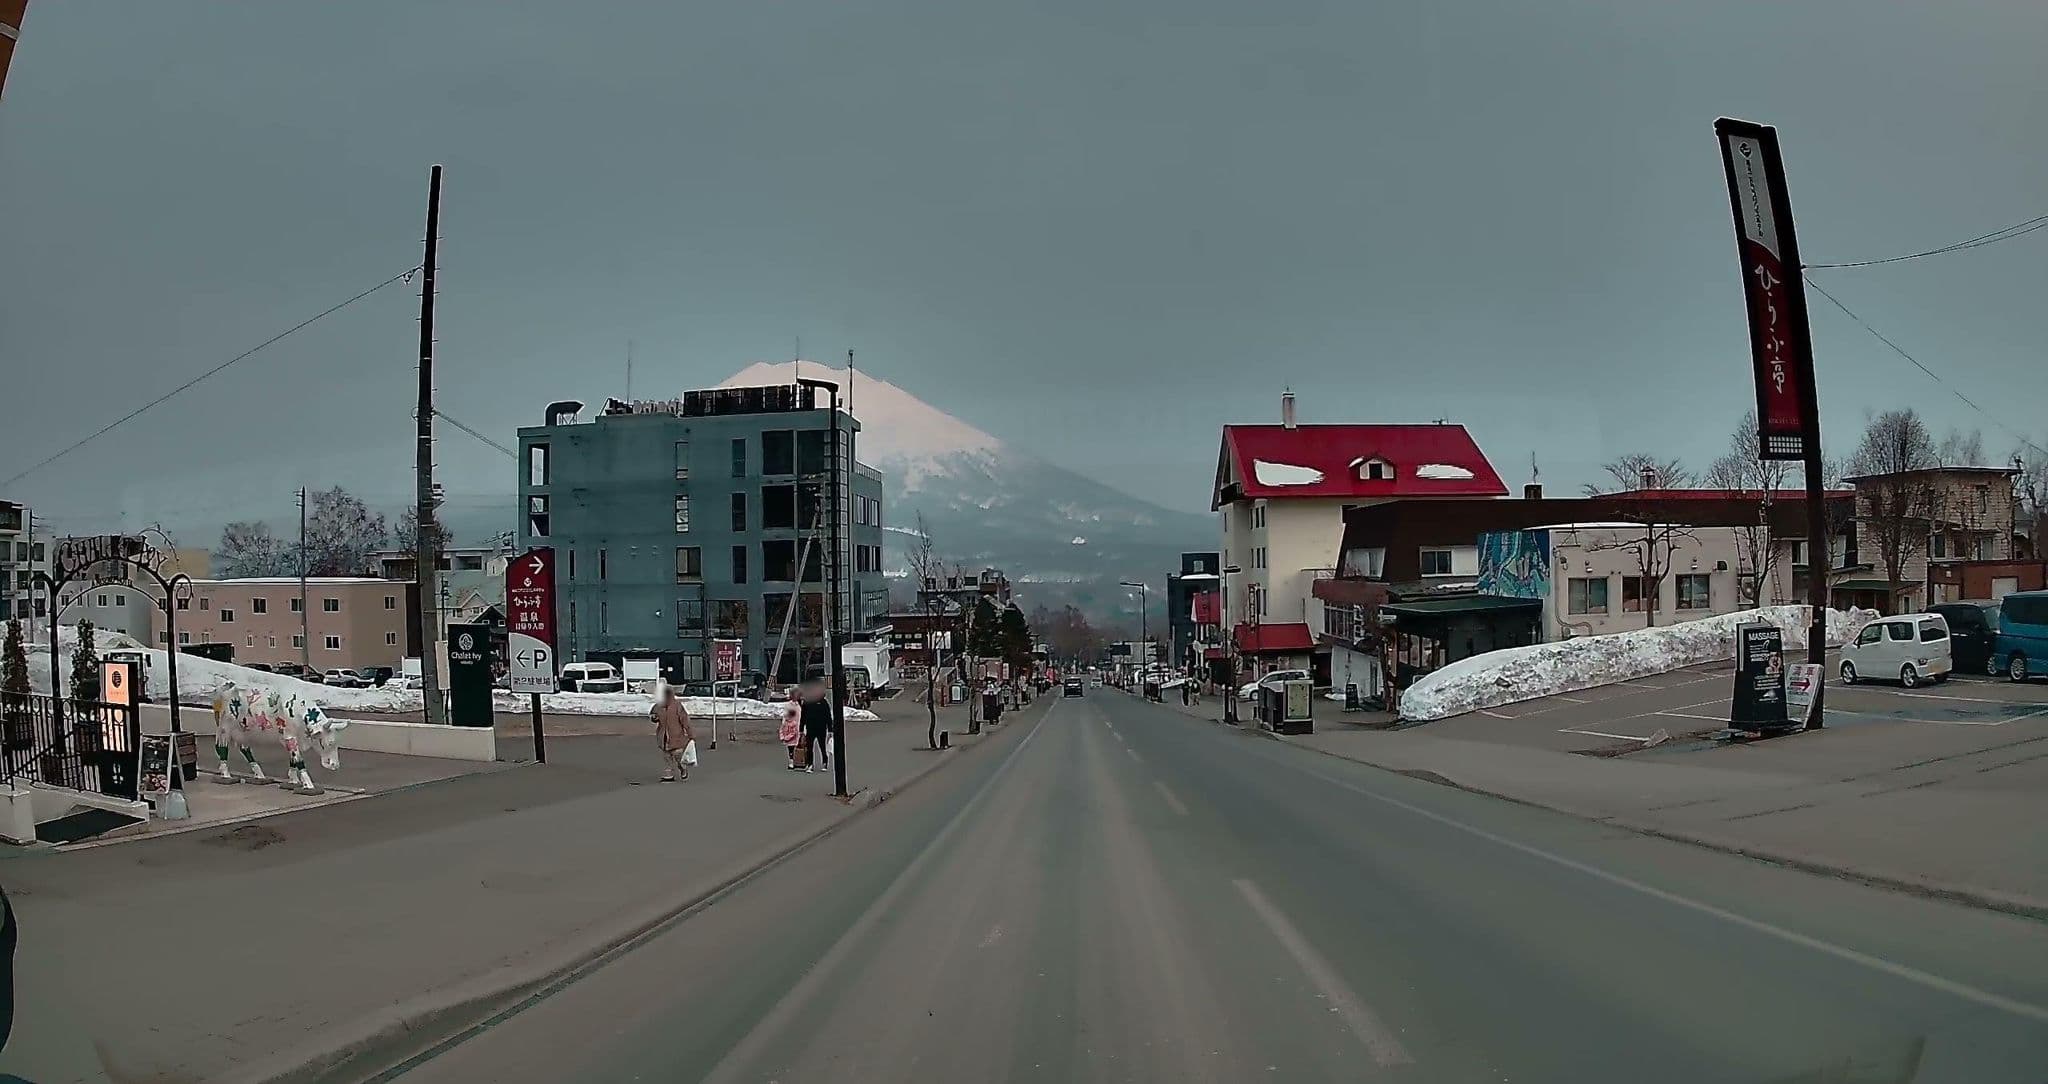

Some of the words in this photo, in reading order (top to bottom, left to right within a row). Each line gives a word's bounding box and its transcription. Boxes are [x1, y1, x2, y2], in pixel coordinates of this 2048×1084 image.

[1755, 264, 1786, 394] ひらふ亭
[520, 611, 538, 622] 温泉
[1748, 631, 1780, 641] MASSAGE
[451, 651, 471, 659] Chalet
[534, 649, 548, 669] P
[735, 646, 741, 660] P
